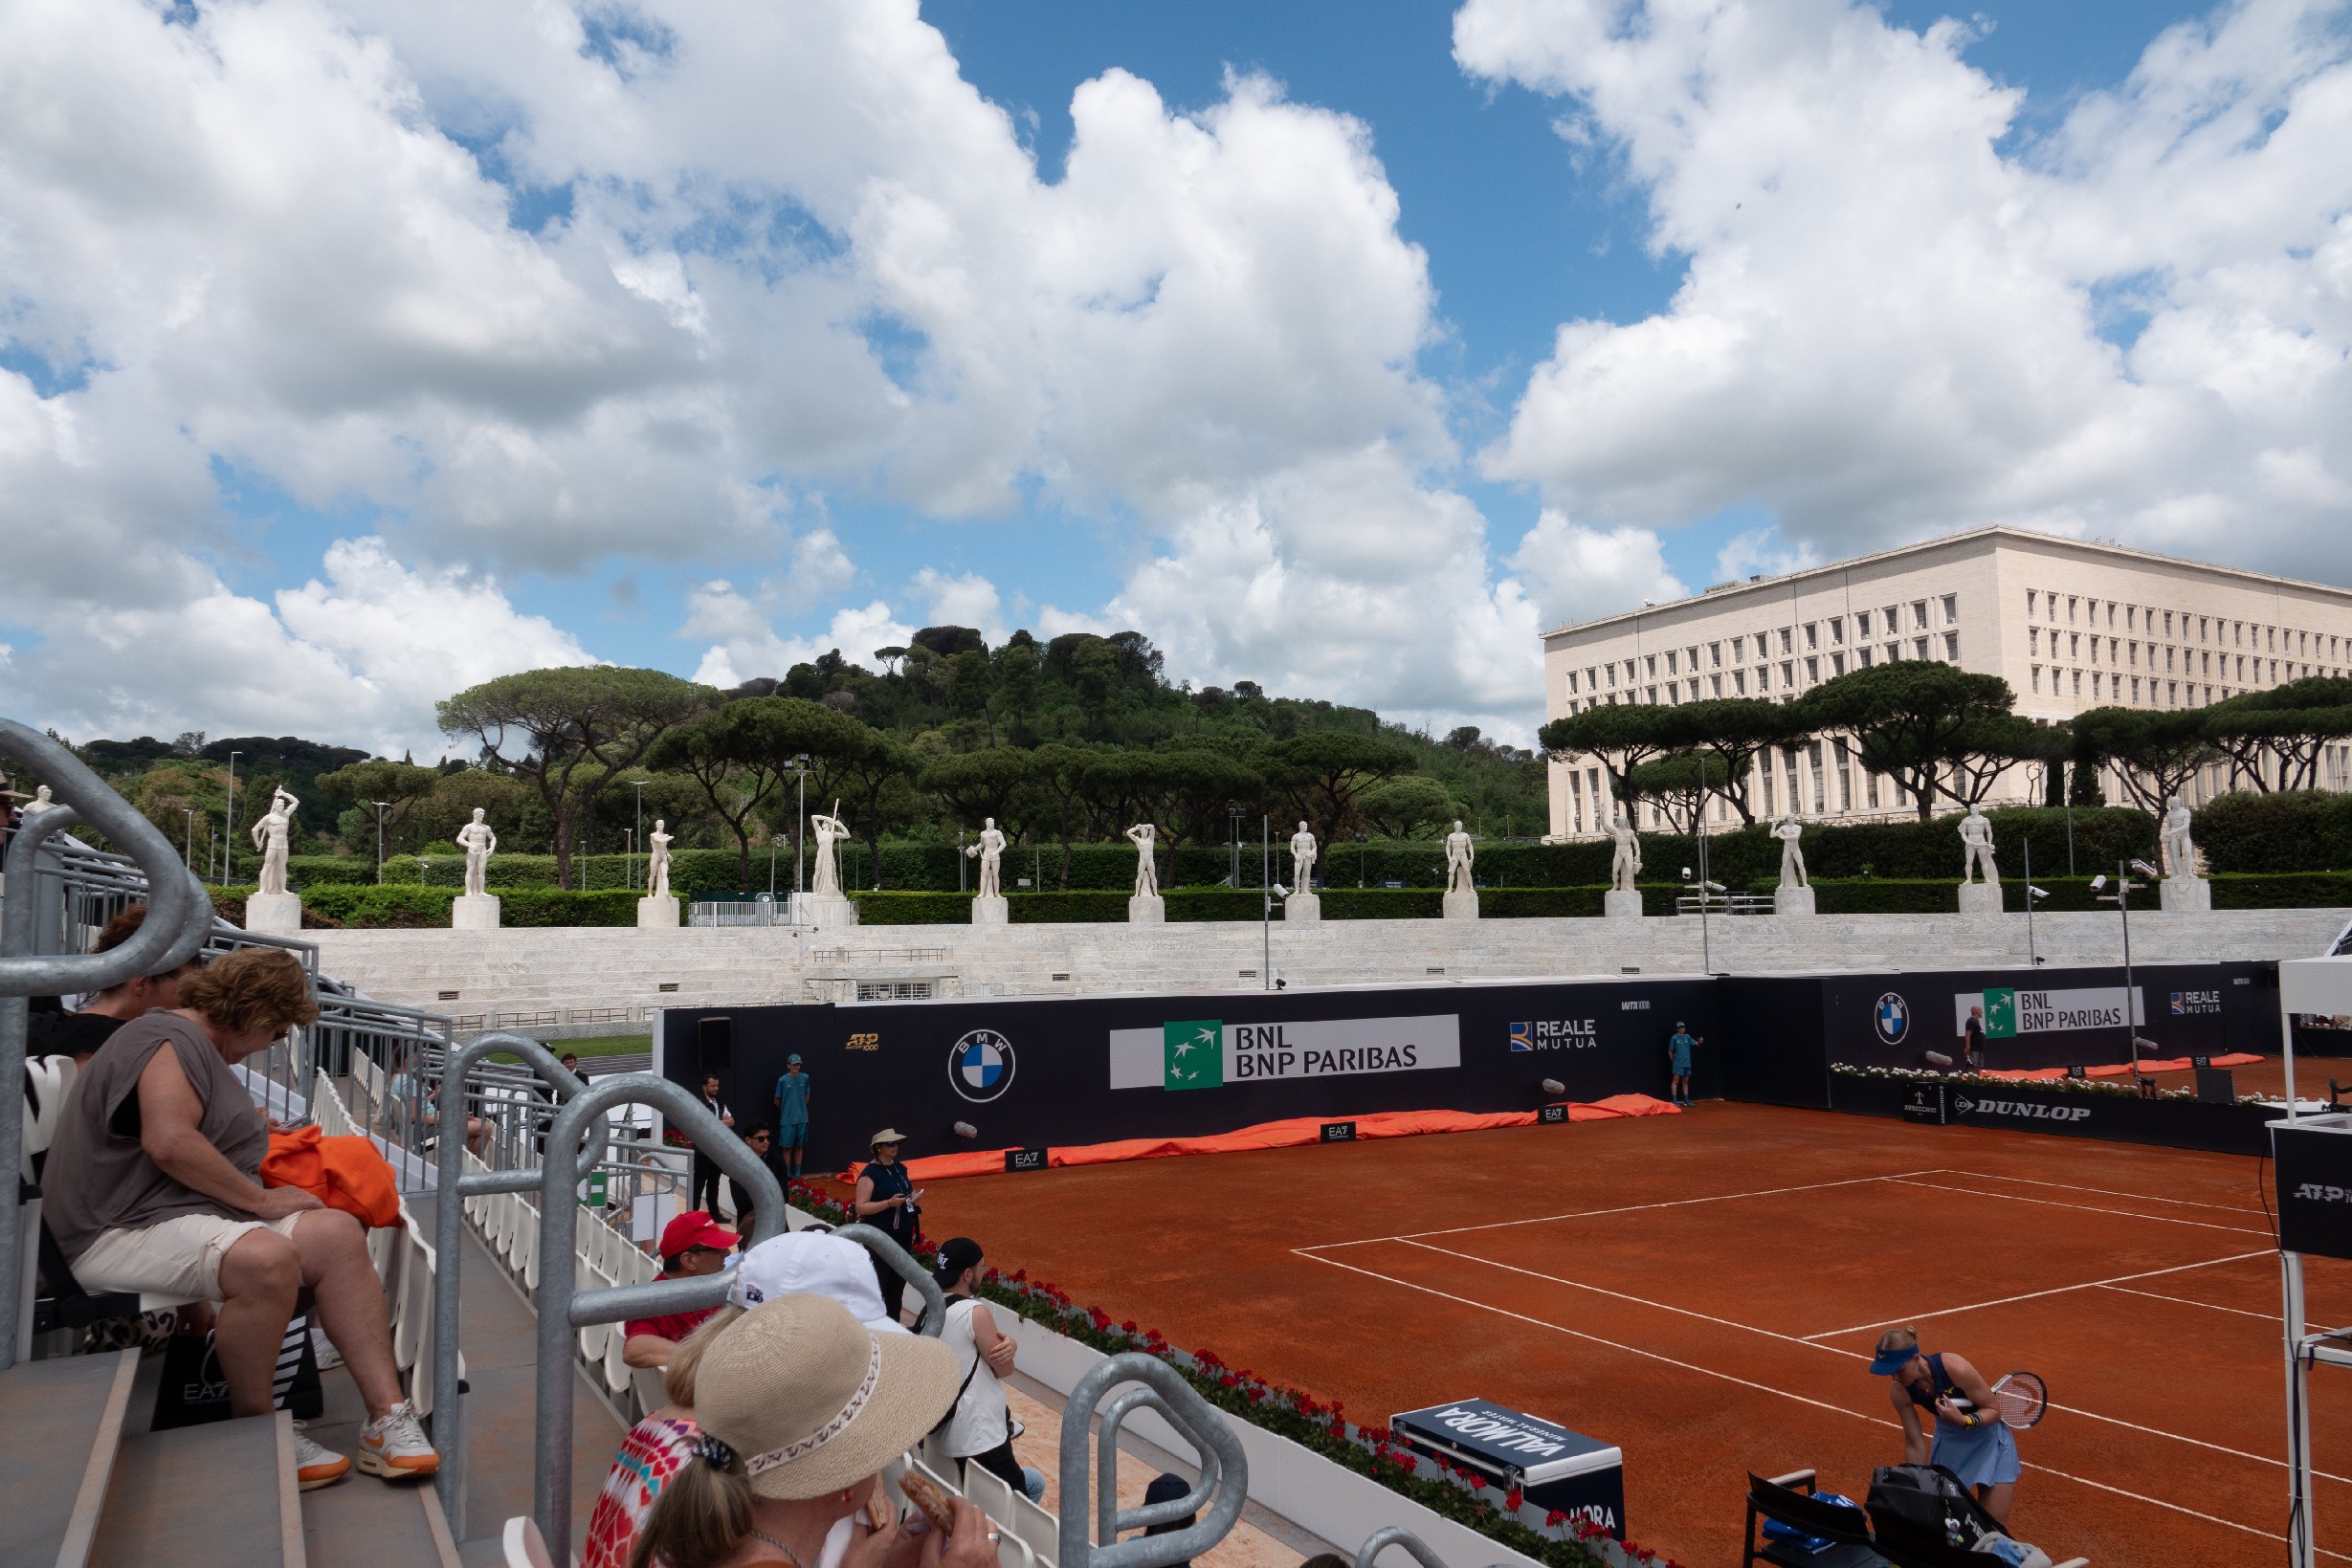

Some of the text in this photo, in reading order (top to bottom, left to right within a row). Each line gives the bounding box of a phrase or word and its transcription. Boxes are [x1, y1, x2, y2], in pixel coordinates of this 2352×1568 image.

[2021, 993, 2052, 1010] BNL
[2186, 991, 2220, 1004] REALE
[2186, 1005, 2221, 1013] MUTUA
[2022, 1008, 2121, 1029] BNP PARIBAS
[1537, 1020, 1596, 1036] REALE
[846, 1033, 878, 1046] ATP
[958, 1033, 1007, 1053] BMW
[1235, 1026, 1292, 1050] BNL
[1537, 1037, 1596, 1049] MUTUA
[1236, 1045, 1417, 1077] BNP PARIBAS
[1976, 1099, 2091, 1121] DUNLOP
[1329, 1125, 1348, 1137] EA7
[1015, 1152, 1039, 1164] EA7
[2292, 1182, 2344, 1203] ATP
[1434, 1406, 1566, 1457] VALMORA
